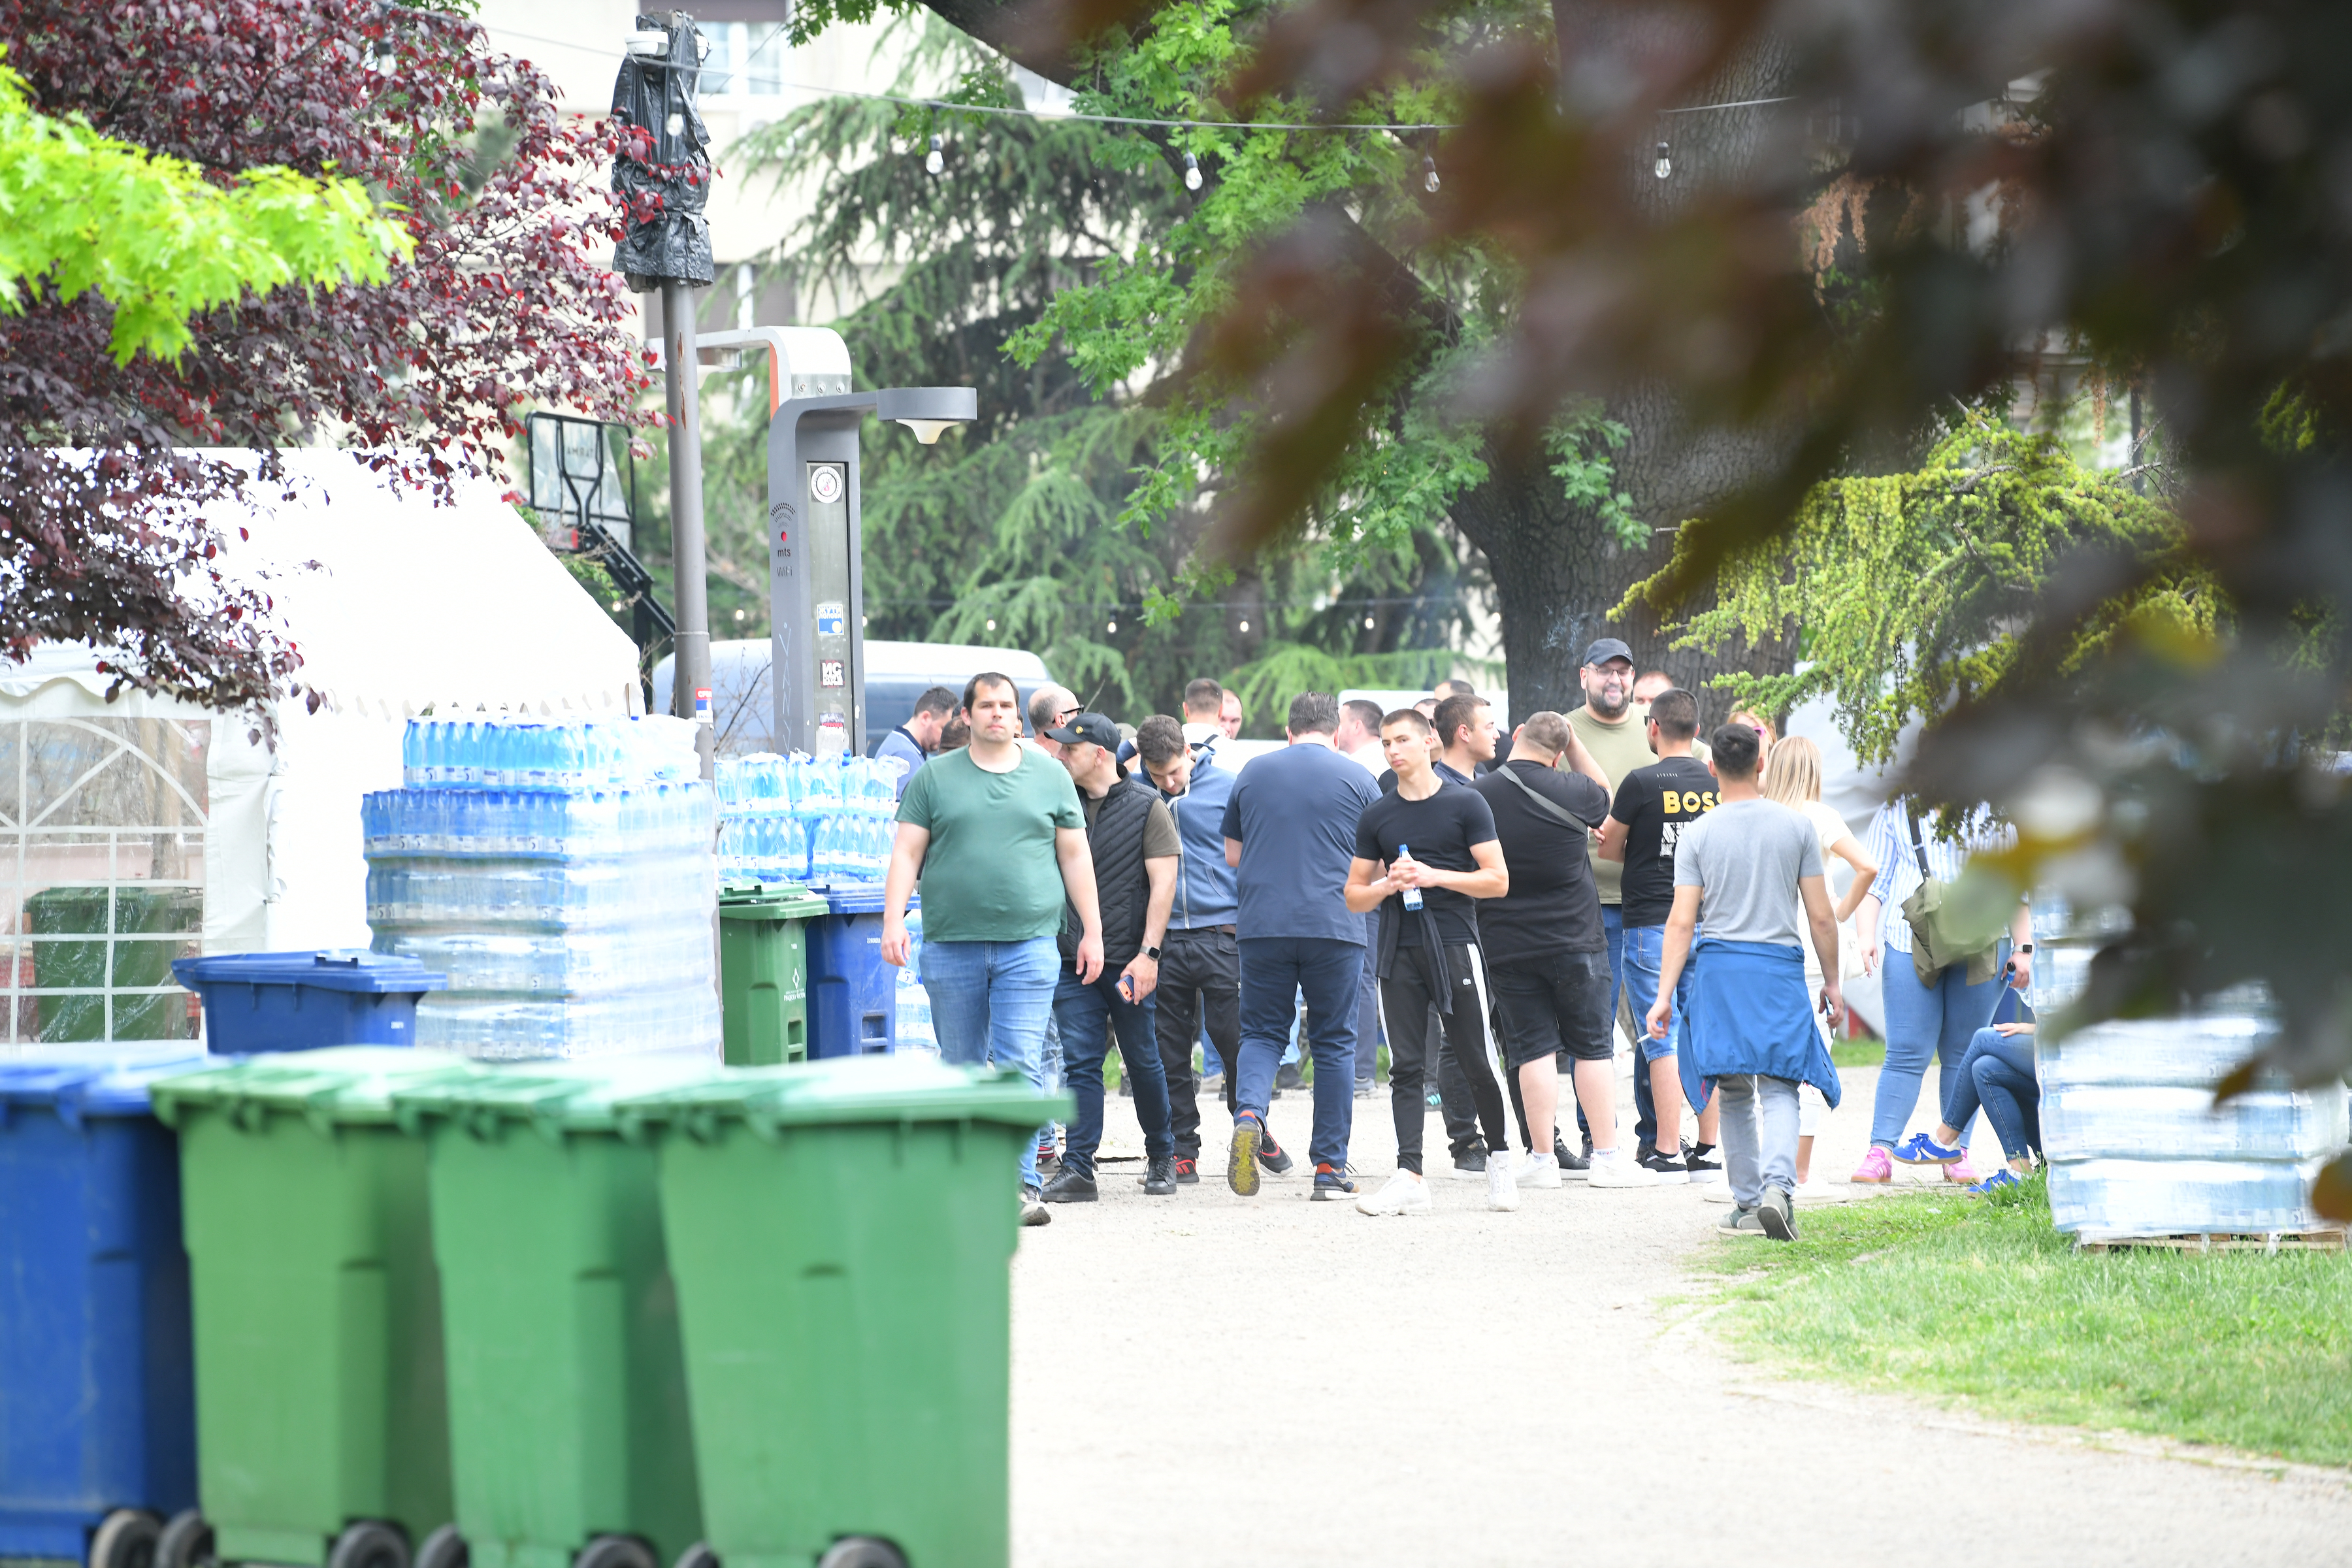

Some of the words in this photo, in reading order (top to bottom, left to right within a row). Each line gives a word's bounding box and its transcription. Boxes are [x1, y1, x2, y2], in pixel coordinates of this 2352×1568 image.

[777, 547, 791, 558] mts
[776, 566, 792, 578] WiFi
[818, 606, 841, 614] ЖУТИ
